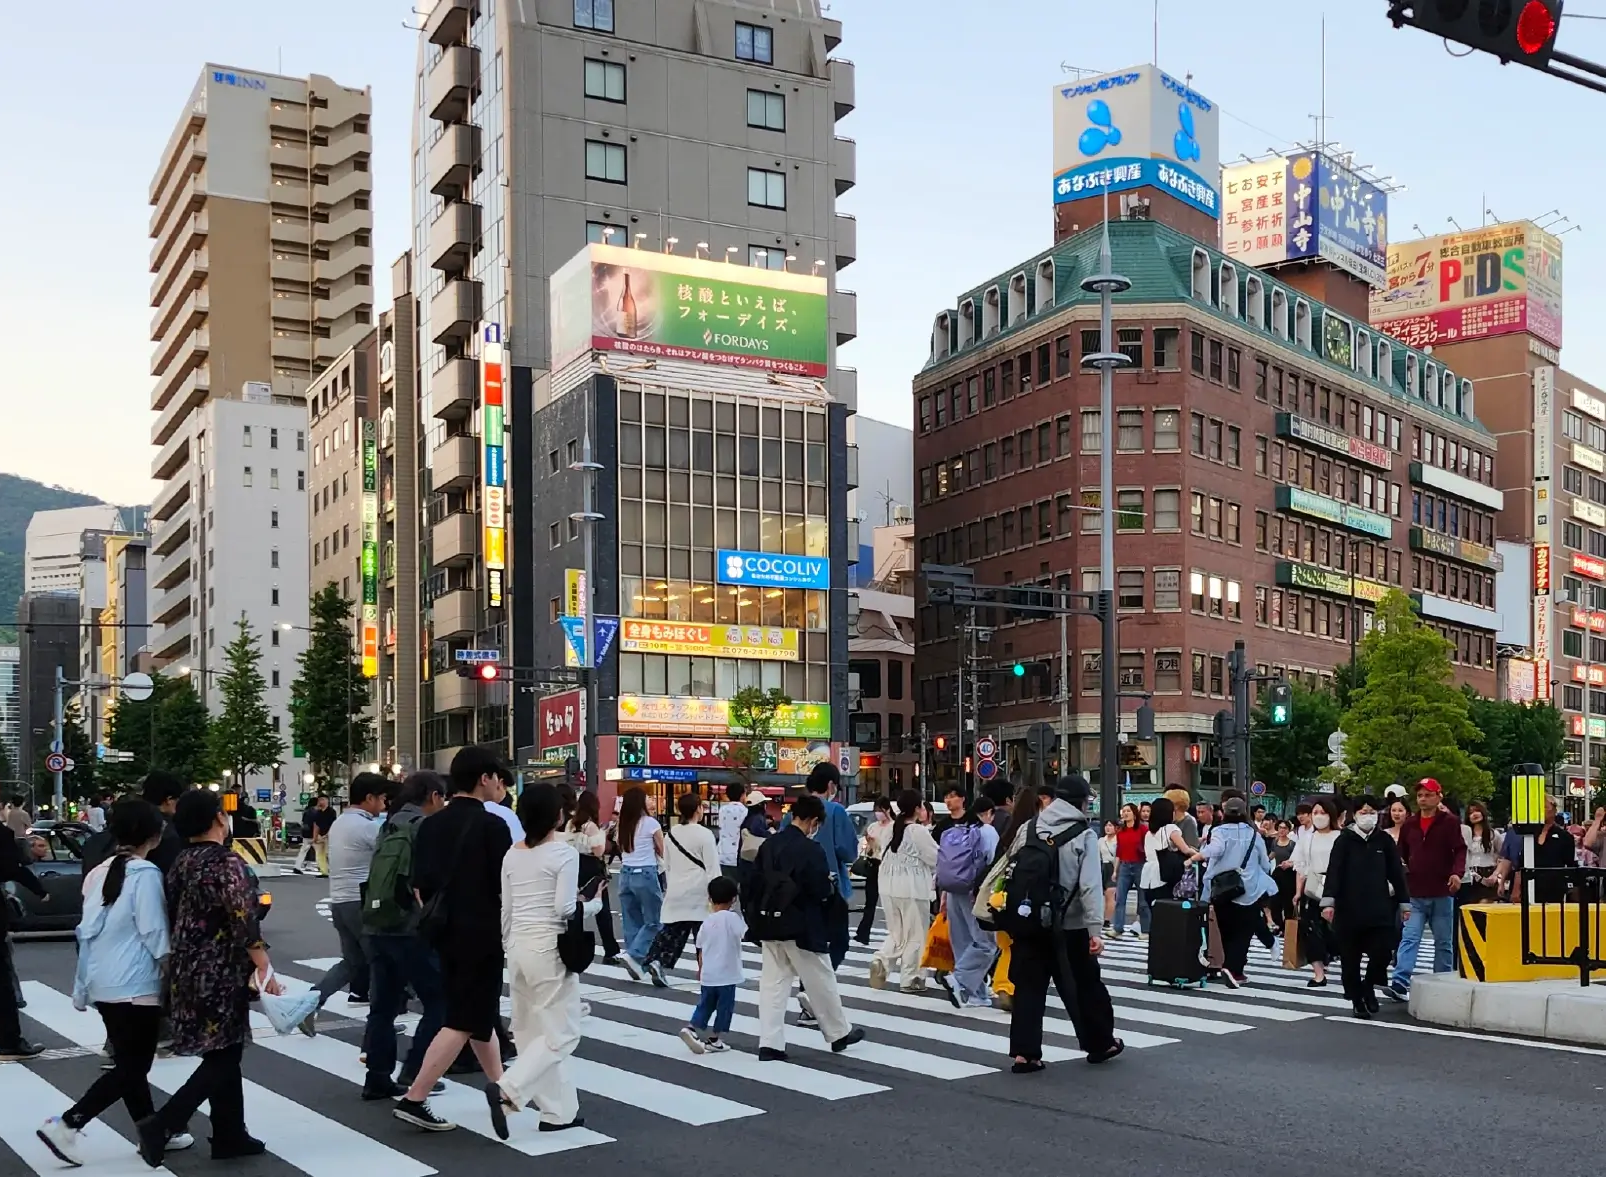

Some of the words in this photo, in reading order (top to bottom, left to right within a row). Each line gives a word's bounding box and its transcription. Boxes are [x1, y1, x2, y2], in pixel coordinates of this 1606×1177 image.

[1057, 162, 1142, 195] あなぶき興産
[1157, 163, 1215, 209] あなぶき興産
[1226, 181, 1239, 255] 七五三
[1241, 178, 1254, 252] お宮参り
[1255, 174, 1269, 249] 安産祈願
[1271, 171, 1284, 246] 子宝祈願
[1292, 183, 1313, 252] 中山寺
[1439, 233, 1525, 259] 総合自動車教習所
[677, 283, 798, 316] 核酸といえば、
[714, 332, 770, 351] FORDAYS
[744, 556, 822, 577] COCOLIV
[1536, 547, 1549, 589] カラオケ
[628, 623, 709, 641] 全身もみほぐし
[545, 705, 574, 736] なか卯
[981, 743, 992, 753] 40
